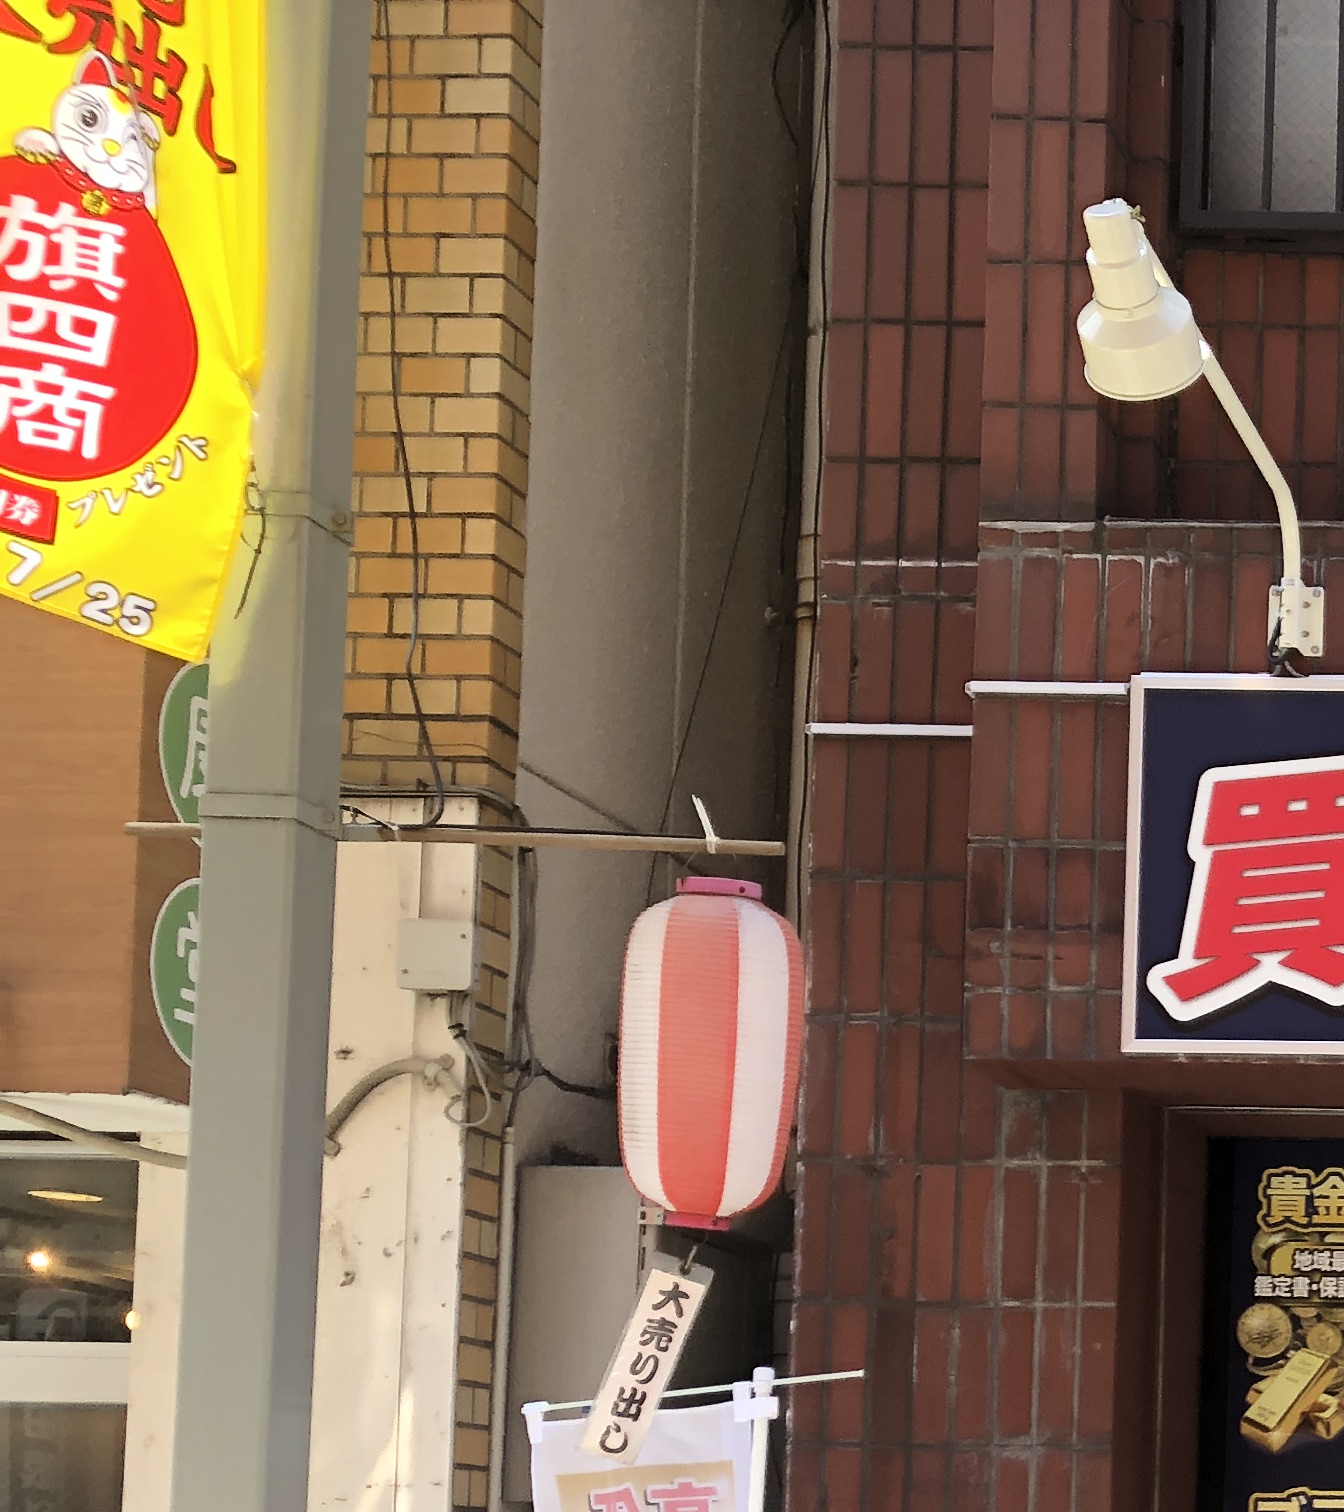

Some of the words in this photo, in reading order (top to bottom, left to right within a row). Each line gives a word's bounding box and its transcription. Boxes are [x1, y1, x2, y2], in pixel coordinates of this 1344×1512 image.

[66, 434, 210, 528] プレゼント
[599, 1283, 691, 1454] 大売り出し
